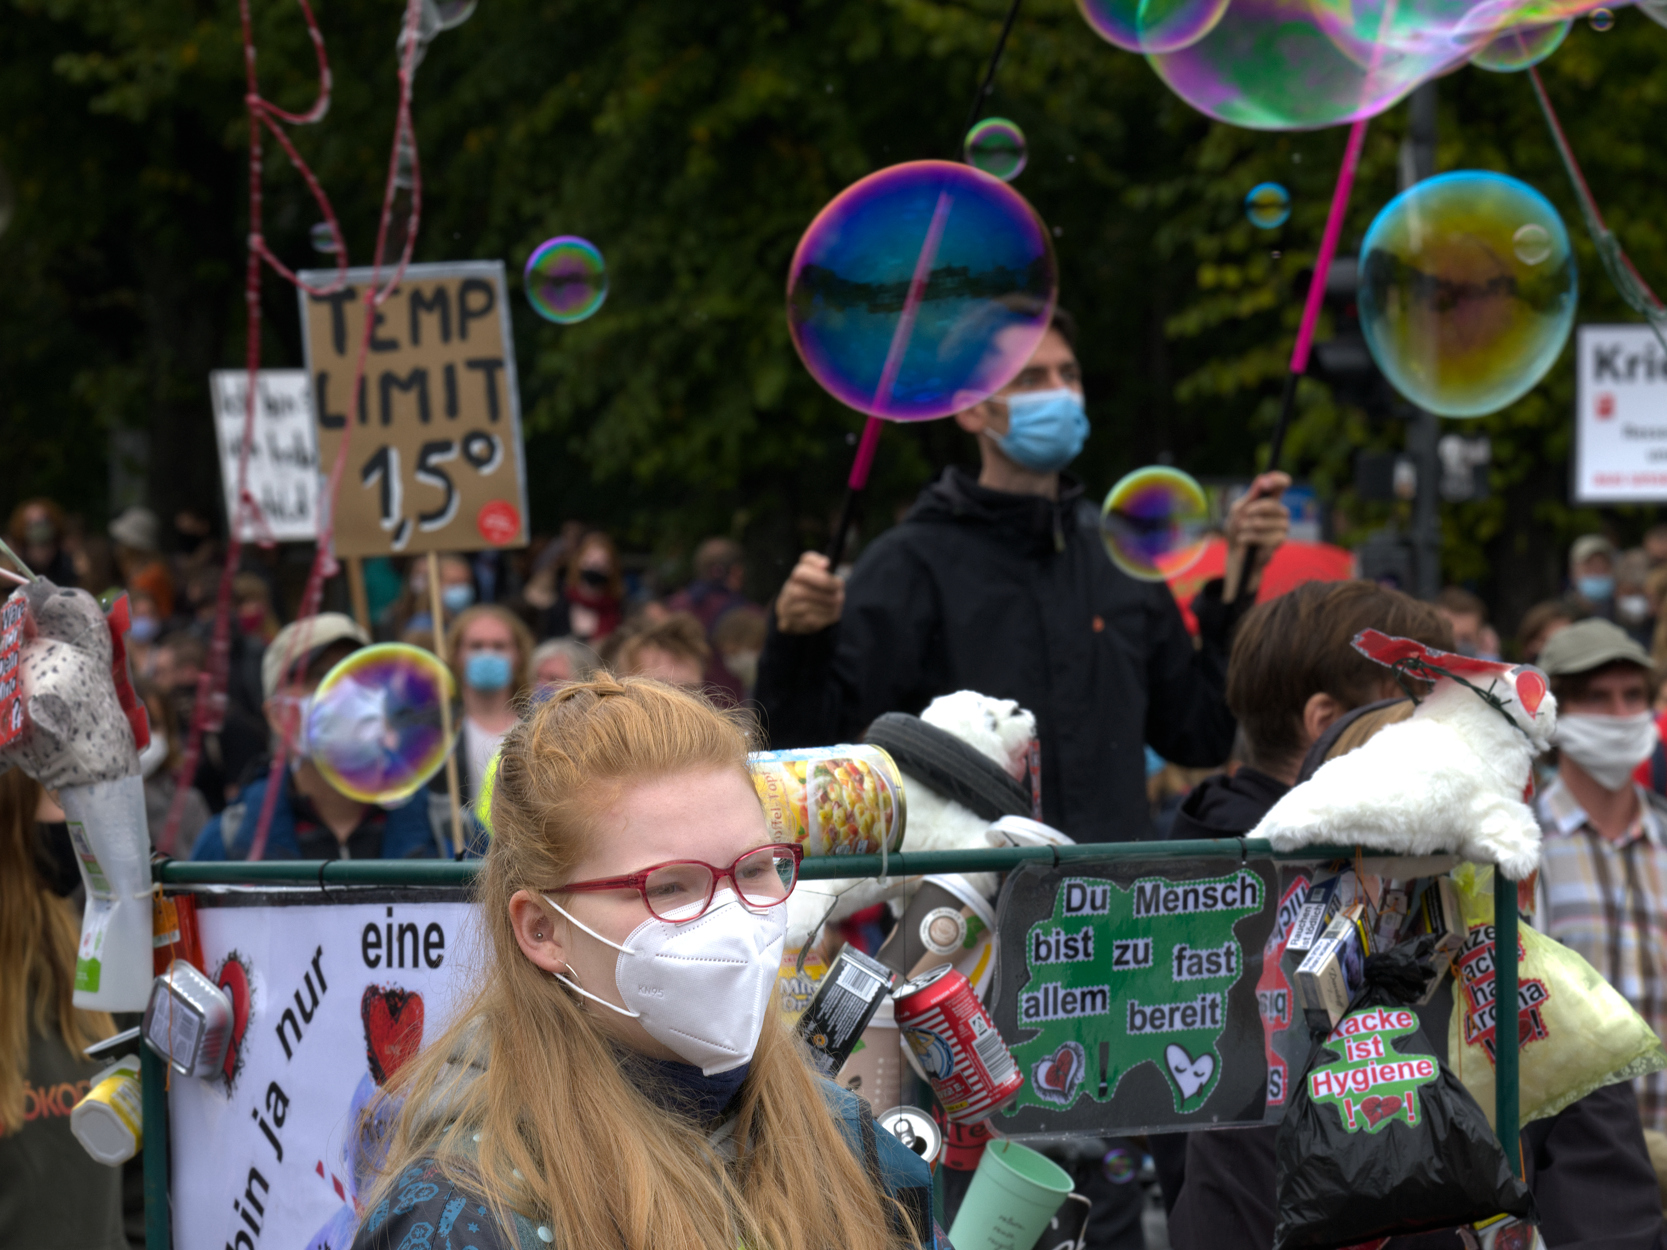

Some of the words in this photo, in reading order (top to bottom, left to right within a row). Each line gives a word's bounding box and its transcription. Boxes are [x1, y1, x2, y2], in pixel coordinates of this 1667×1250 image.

[310, 277, 495, 356] TEMP
[1594, 343, 1667, 383] Kri
[316, 358, 504, 428] LIMIT
[1064, 882, 1108, 913] Du
[1134, 875, 1257, 915] Mensch
[361, 906, 445, 970] eine
[1033, 930, 1093, 963] bist
[1114, 941, 1150, 967] zu
[1174, 943, 1235, 977] fast
[638, 984, 664, 1000] KN95
[1023, 985, 1107, 1019] allem
[1128, 994, 1220, 1032] bereit
[251, 1080, 291, 1163] ja
[275, 945, 328, 1061] nur
[1346, 1034, 1384, 1061] ist
[1312, 1059, 1434, 1097] Hygiene
